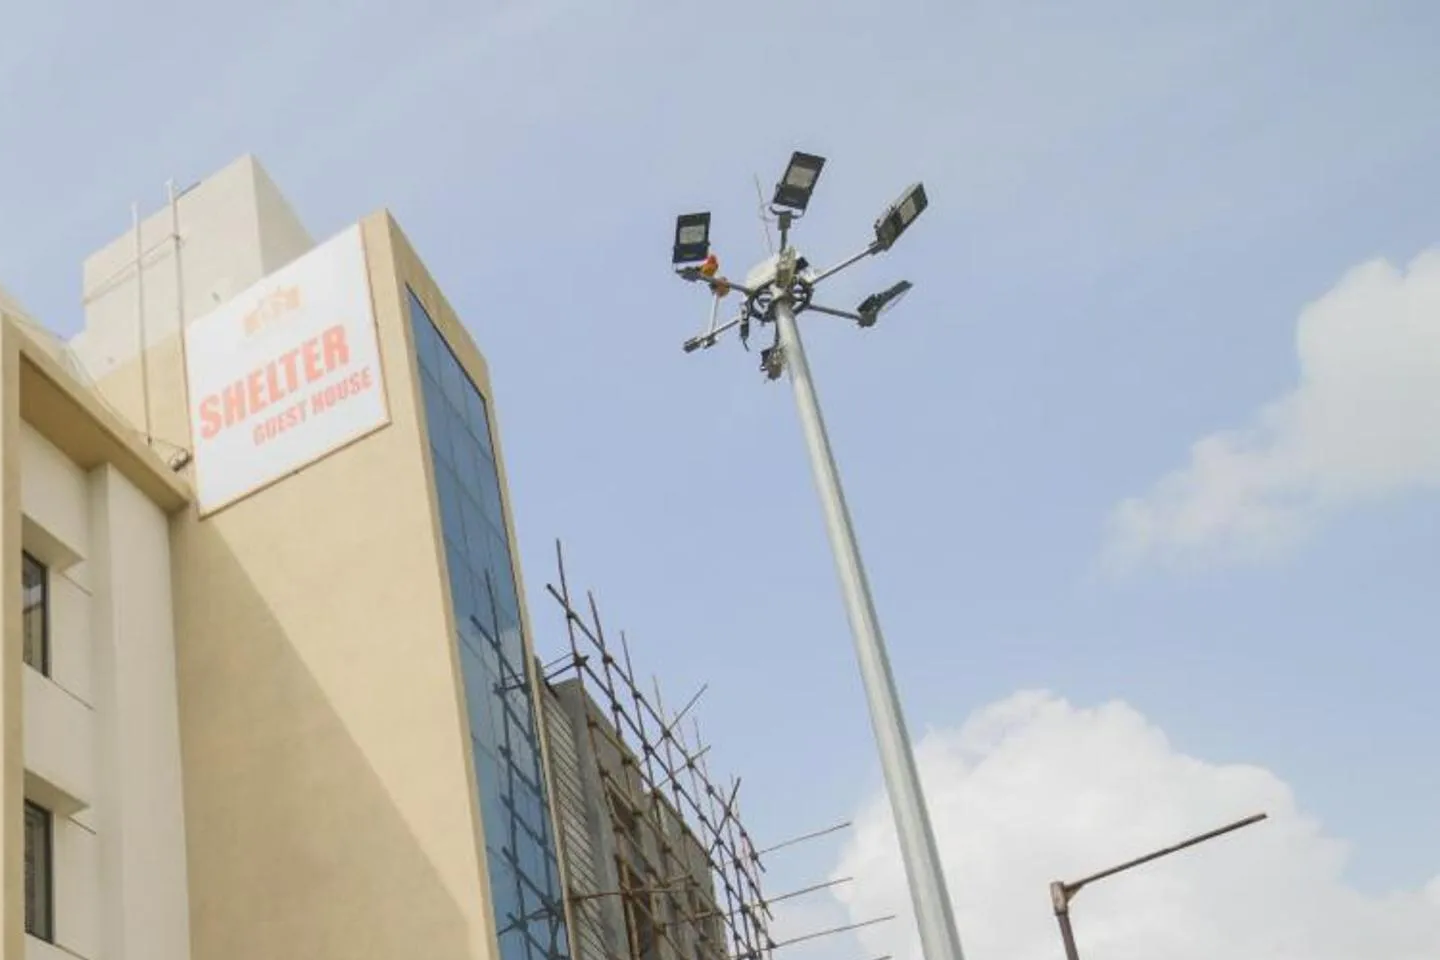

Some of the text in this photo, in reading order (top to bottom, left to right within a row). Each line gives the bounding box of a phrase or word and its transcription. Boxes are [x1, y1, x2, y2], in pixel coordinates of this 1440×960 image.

[199, 324, 350, 440] SHELTER
[252, 366, 374, 446] GUEST HOUSE
